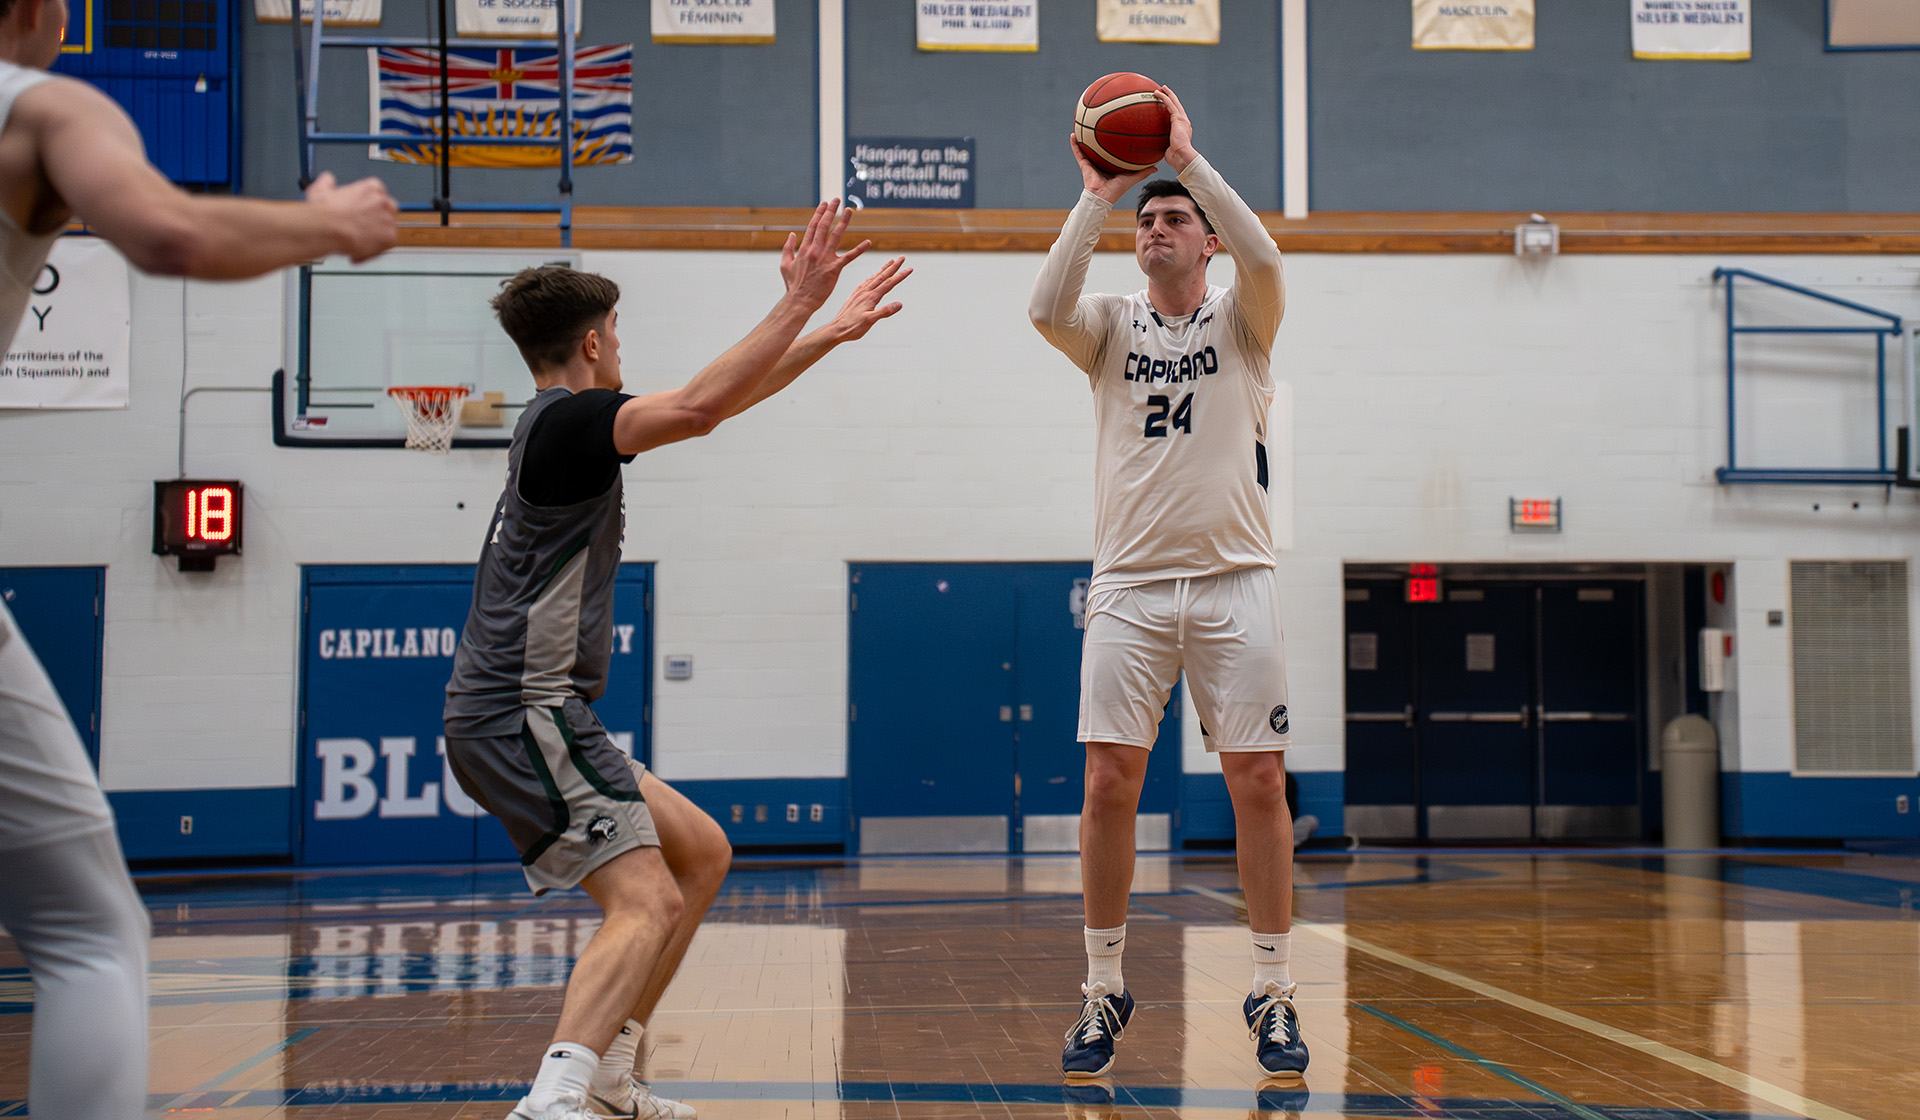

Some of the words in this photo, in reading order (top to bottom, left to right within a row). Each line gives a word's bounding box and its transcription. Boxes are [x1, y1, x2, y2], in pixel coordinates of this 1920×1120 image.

[680, 9, 744, 24] FÉMININ
[921, 4, 965, 16] SILVER
[970, 4, 1031, 17] MEDALIST
[1438, 5, 1509, 17] MASCULIN
[1637, 11, 1680, 23] SILVER
[1684, 11, 1744, 24] MEDALIST
[855, 144, 919, 165] Hanging
[921, 148, 942, 162] on
[944, 145, 969, 163] the
[938, 163, 969, 181] Rim
[866, 181, 880, 199] is
[883, 181, 962, 200] Prohibited
[5, 349, 65, 361] territories
[68, 349, 81, 361] of
[84, 350, 104, 361] the
[16, 366, 83, 379] (Squamish)
[87, 366, 110, 378] and
[1124, 346, 1218, 384] CAPILANO
[1144, 392, 1195, 438] 24
[187, 487, 232, 541] 18
[319, 626, 456, 660] CAPILANO
